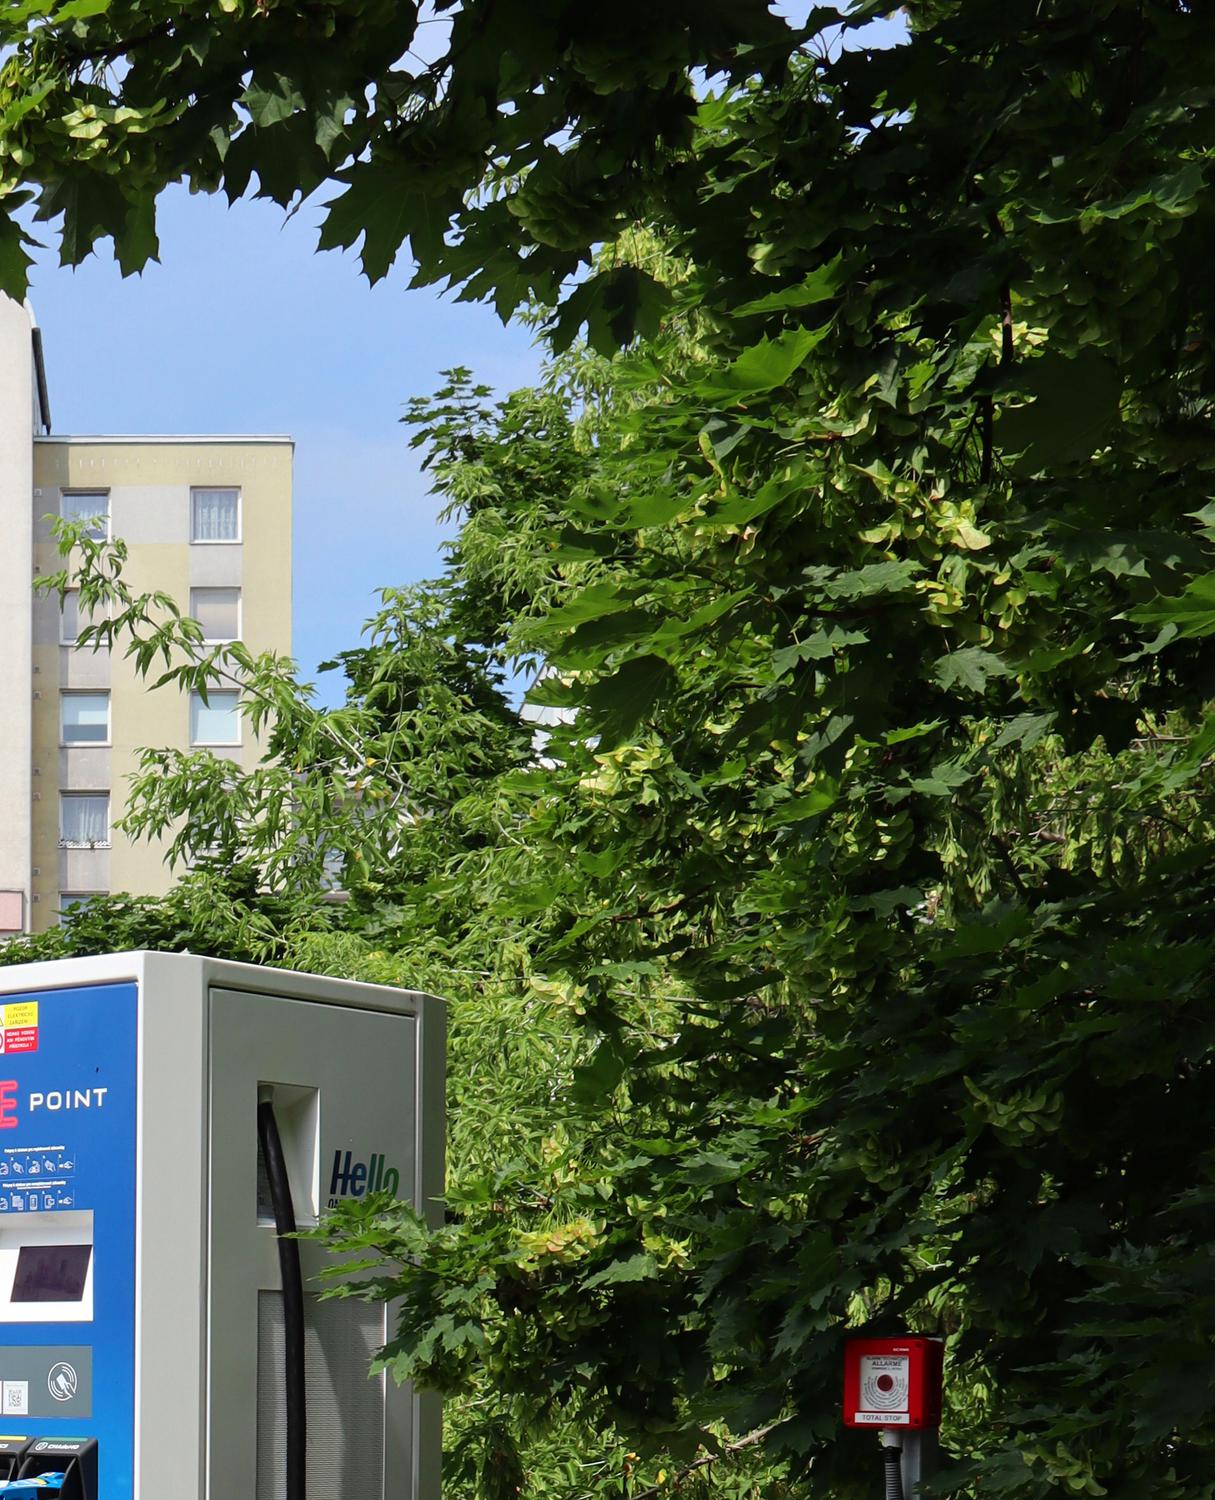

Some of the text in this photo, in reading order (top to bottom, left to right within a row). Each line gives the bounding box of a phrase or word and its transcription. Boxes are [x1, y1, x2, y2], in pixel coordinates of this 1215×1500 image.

[29, 1087, 108, 1113] POINT
[329, 1149, 400, 1200] Hello
[884, 1414, 902, 1422] STOP
